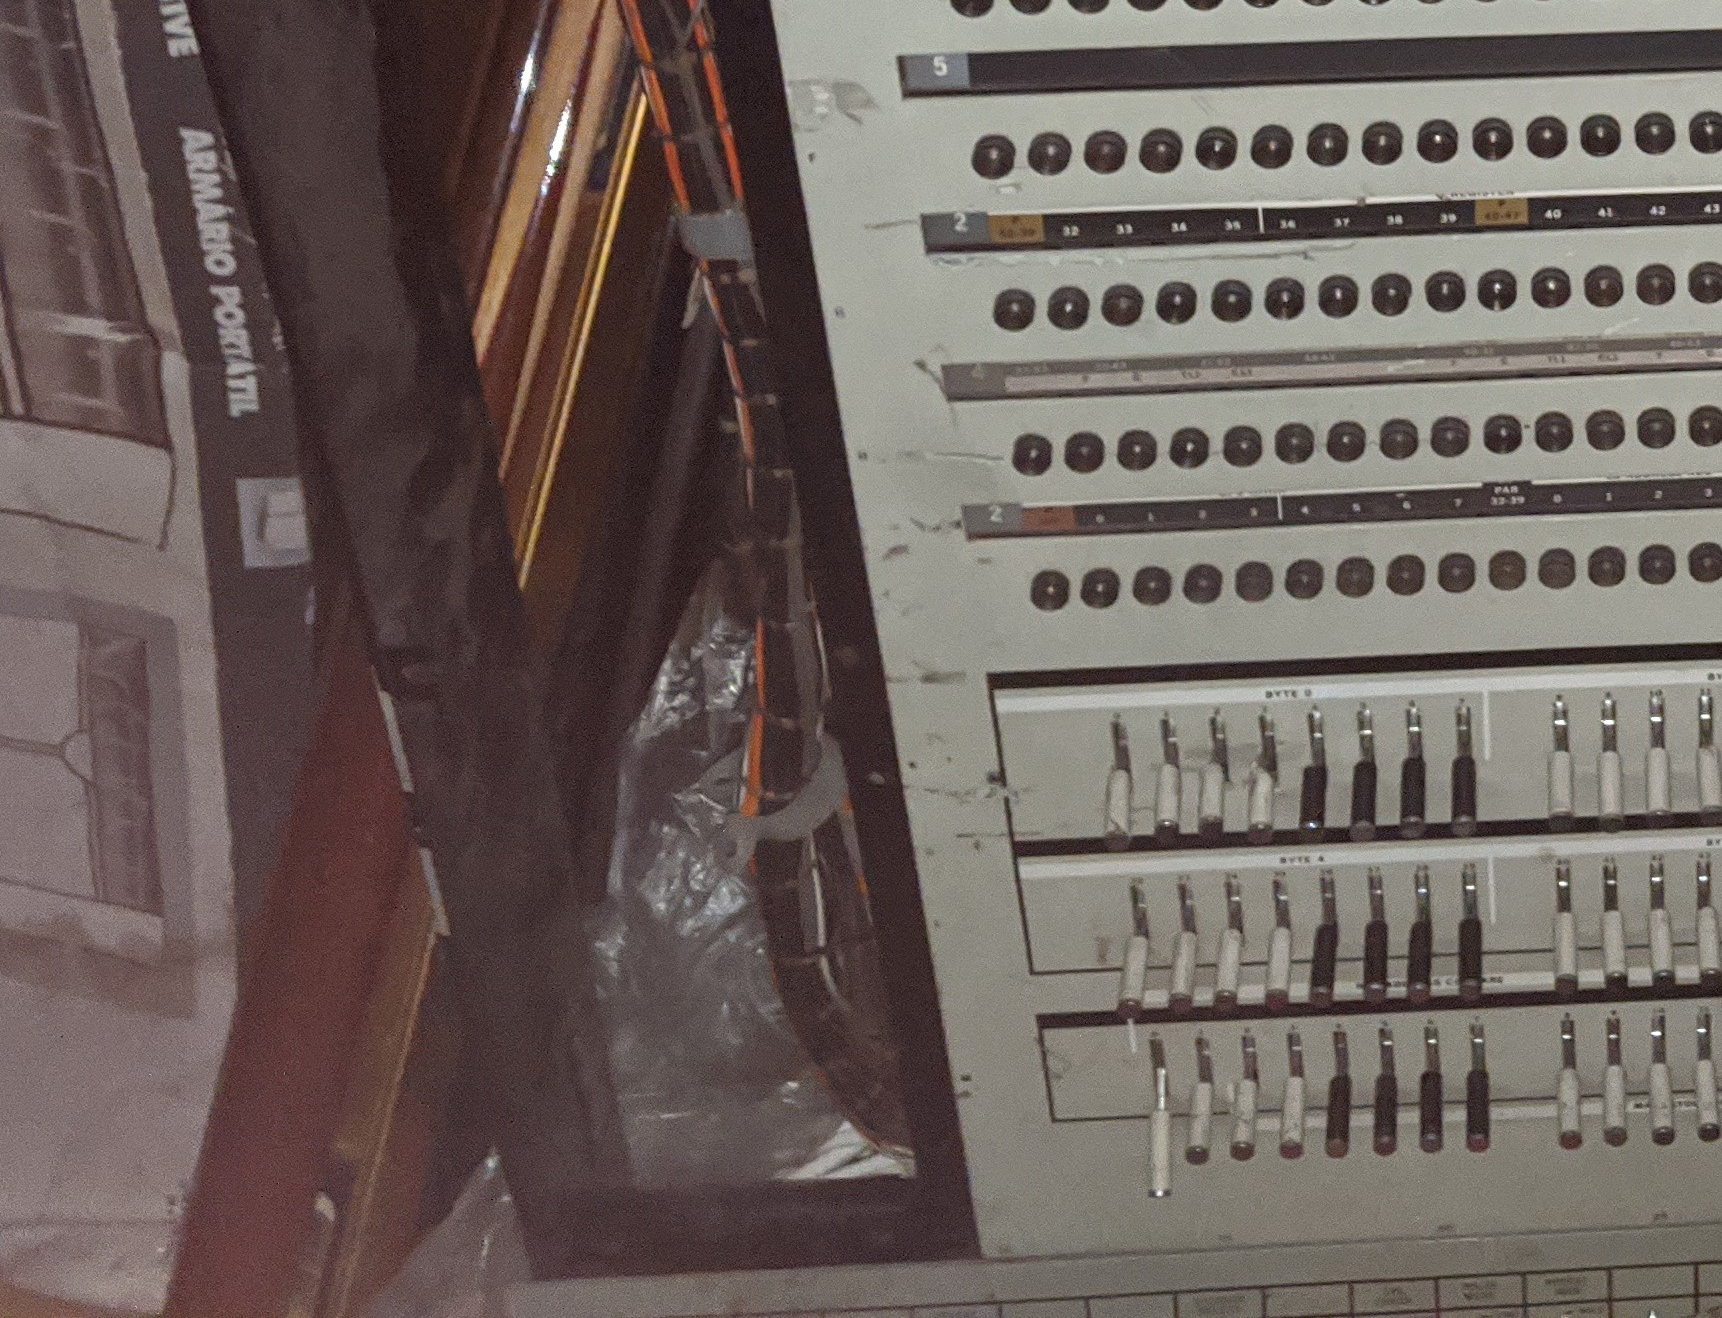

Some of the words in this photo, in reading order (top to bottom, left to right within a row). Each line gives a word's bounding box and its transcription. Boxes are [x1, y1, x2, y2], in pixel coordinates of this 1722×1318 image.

[932, 56, 948, 77] 5
[954, 212, 970, 231] 2
[1264, 689, 1298, 700] BYTE
